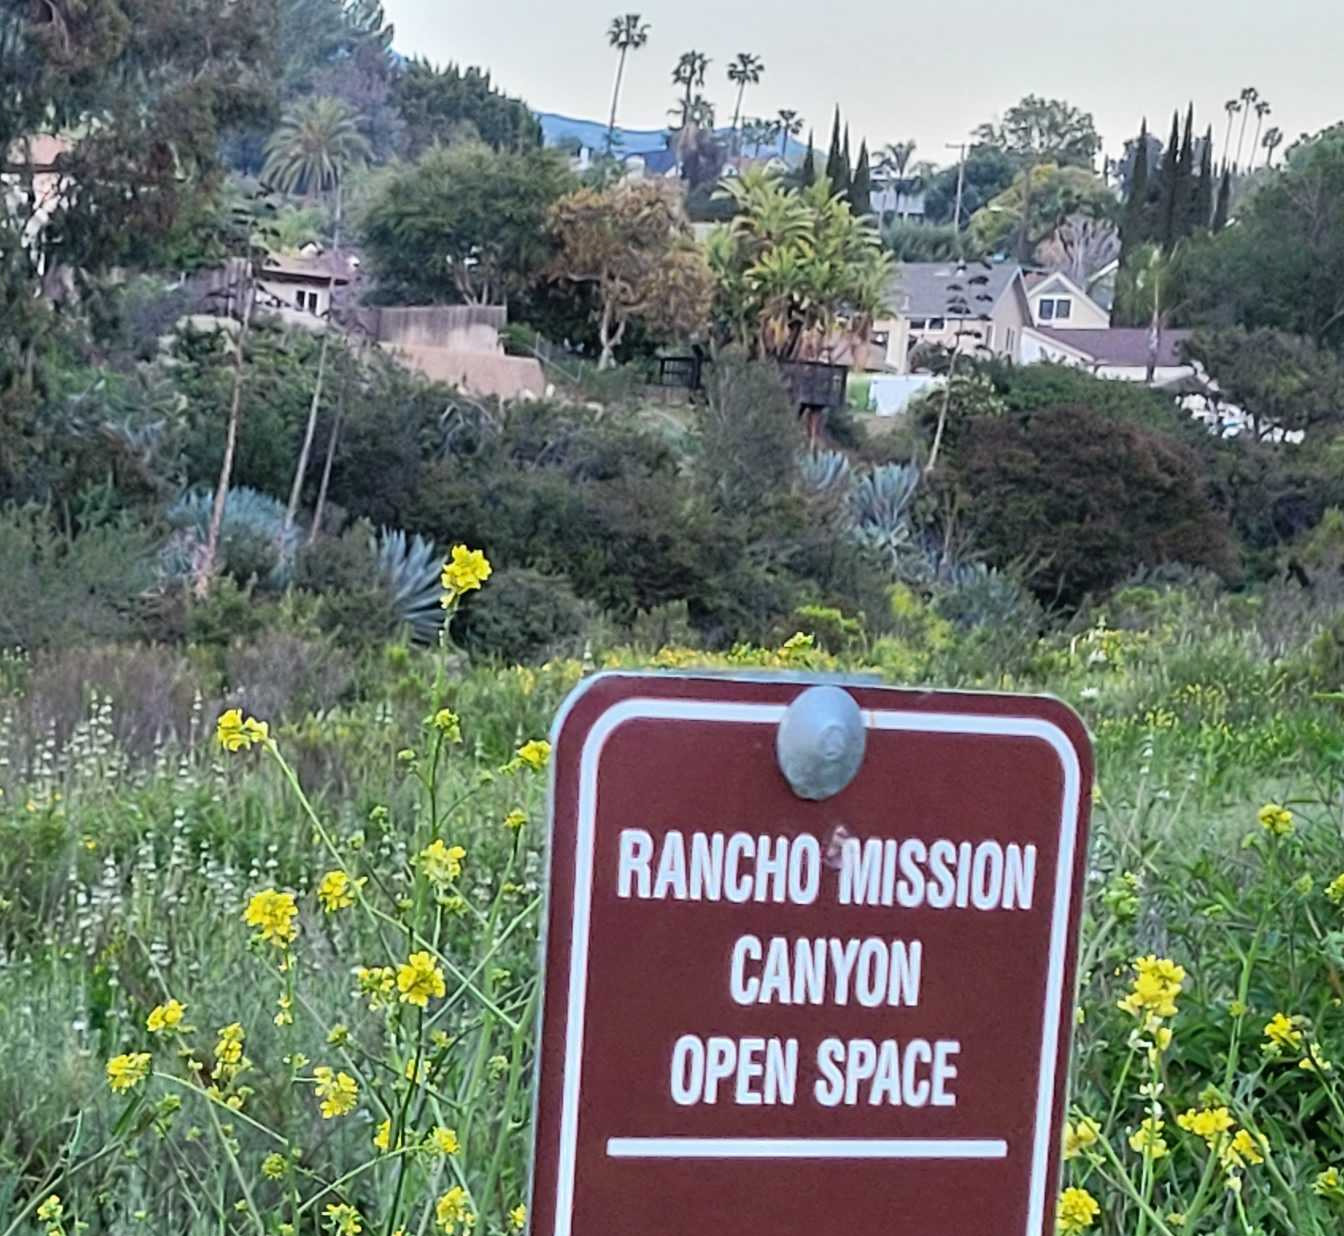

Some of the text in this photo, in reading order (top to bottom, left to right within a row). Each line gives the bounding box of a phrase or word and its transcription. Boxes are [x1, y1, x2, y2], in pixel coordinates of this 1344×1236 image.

[617, 828, 1037, 911] RANCHO MISSION
[729, 934, 922, 1006] CANYON
[670, 1034, 961, 1108] OPEN SPACE
